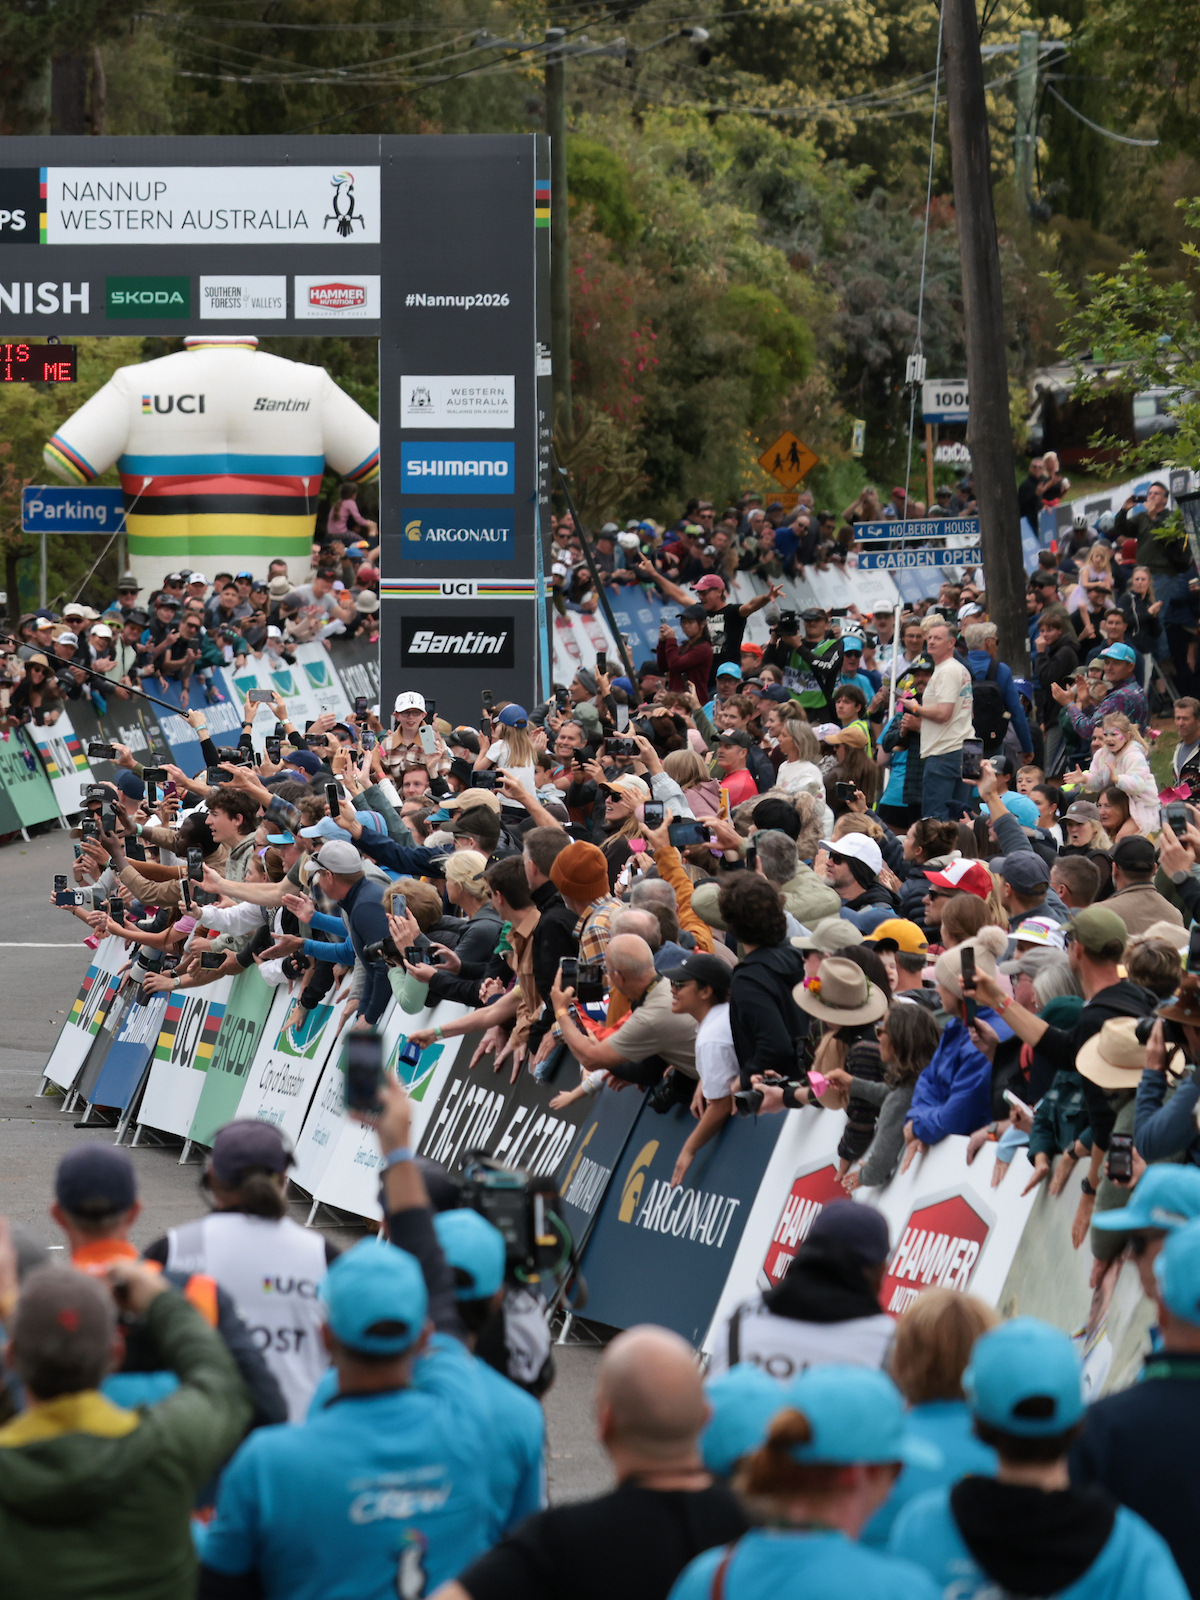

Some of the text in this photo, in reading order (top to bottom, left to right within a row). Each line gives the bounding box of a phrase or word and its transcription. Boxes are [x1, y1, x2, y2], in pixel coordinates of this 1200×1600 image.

[62, 181, 167, 201] NANNUP
[61, 209, 309, 230] WESTERN AUSTRALIA
[204, 286, 242, 298] SOUTHERN
[310, 288, 365, 300] HAMMER
[211, 298, 282, 308] FORESTS VALLEYS
[405, 294, 510, 310] #Nannup2026
[44, 363, 72, 381] ME
[154, 394, 205, 414] UCI
[253, 398, 311, 412] Santini
[936, 392, 969, 406] 100
[406, 460, 508, 476] SHIMANO
[28, 500, 107, 525] Parking
[426, 528, 510, 542] ARGONAUT
[889, 520, 977, 537] HOLBERRY HOUSE
[876, 550, 982, 568] GARDEN OPEN
[442, 584, 473, 595] UCI
[408, 631, 508, 654] Santini
[76, 968, 113, 1032] UCI
[172, 996, 208, 1068] UCI
[423, 1076, 505, 1174] FACTOR
[636, 1179, 740, 1248] ARGONAUT
[888, 1226, 980, 1292] HAMMER
[252, 1327, 306, 1353] OST
